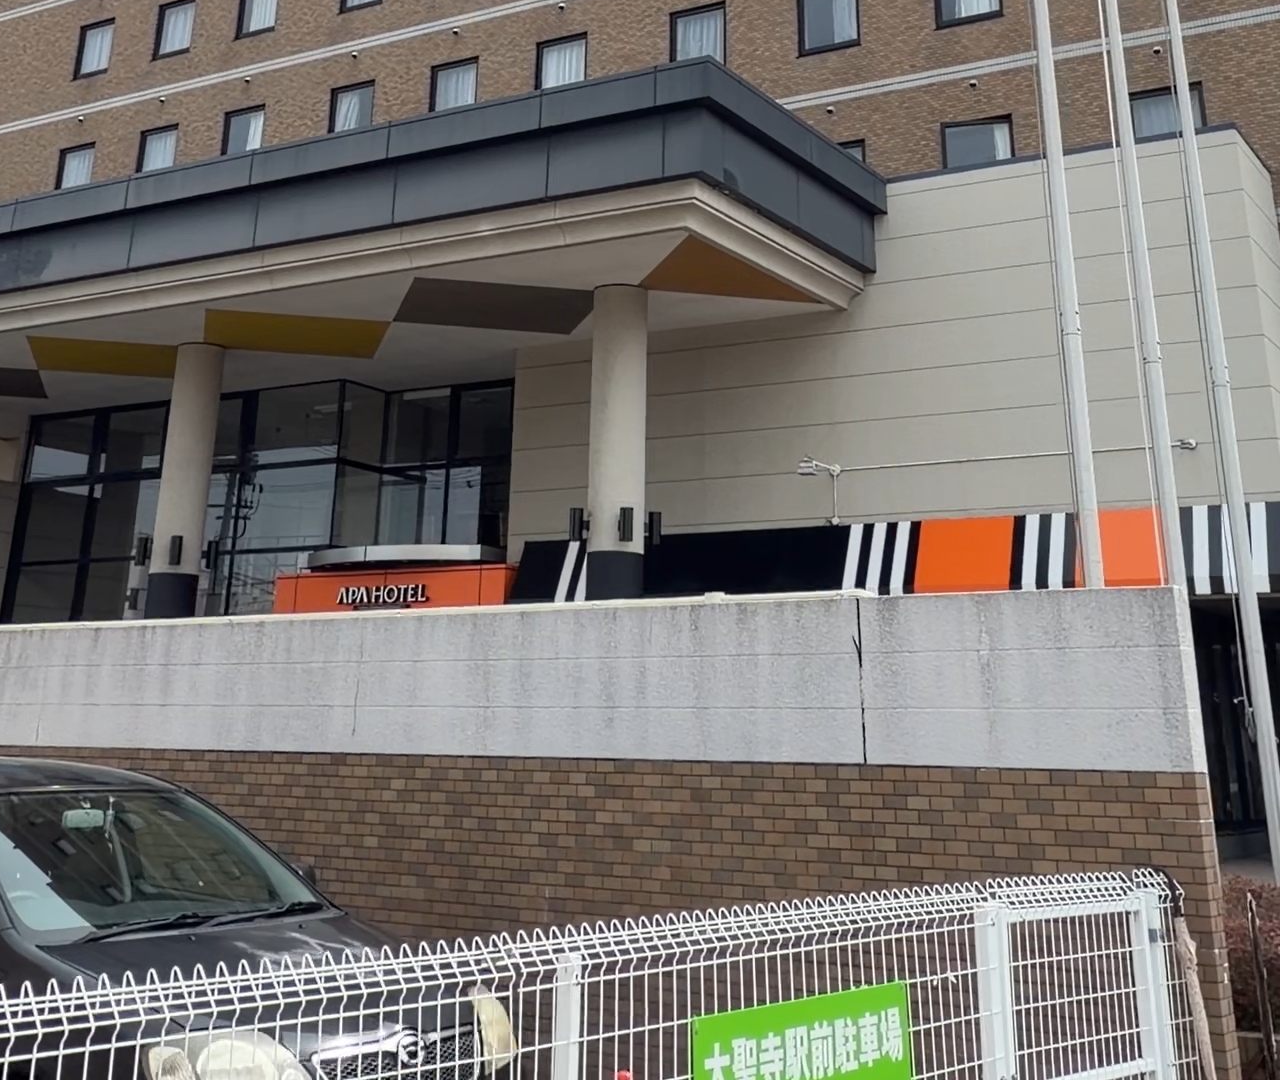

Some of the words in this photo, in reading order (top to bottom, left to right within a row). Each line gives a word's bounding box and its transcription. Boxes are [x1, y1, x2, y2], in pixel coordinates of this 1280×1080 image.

[336, 586, 368, 604] APA
[372, 583, 426, 603] HOTEL
[704, 1006, 904, 1080] 大聖寺駅前駐車場
